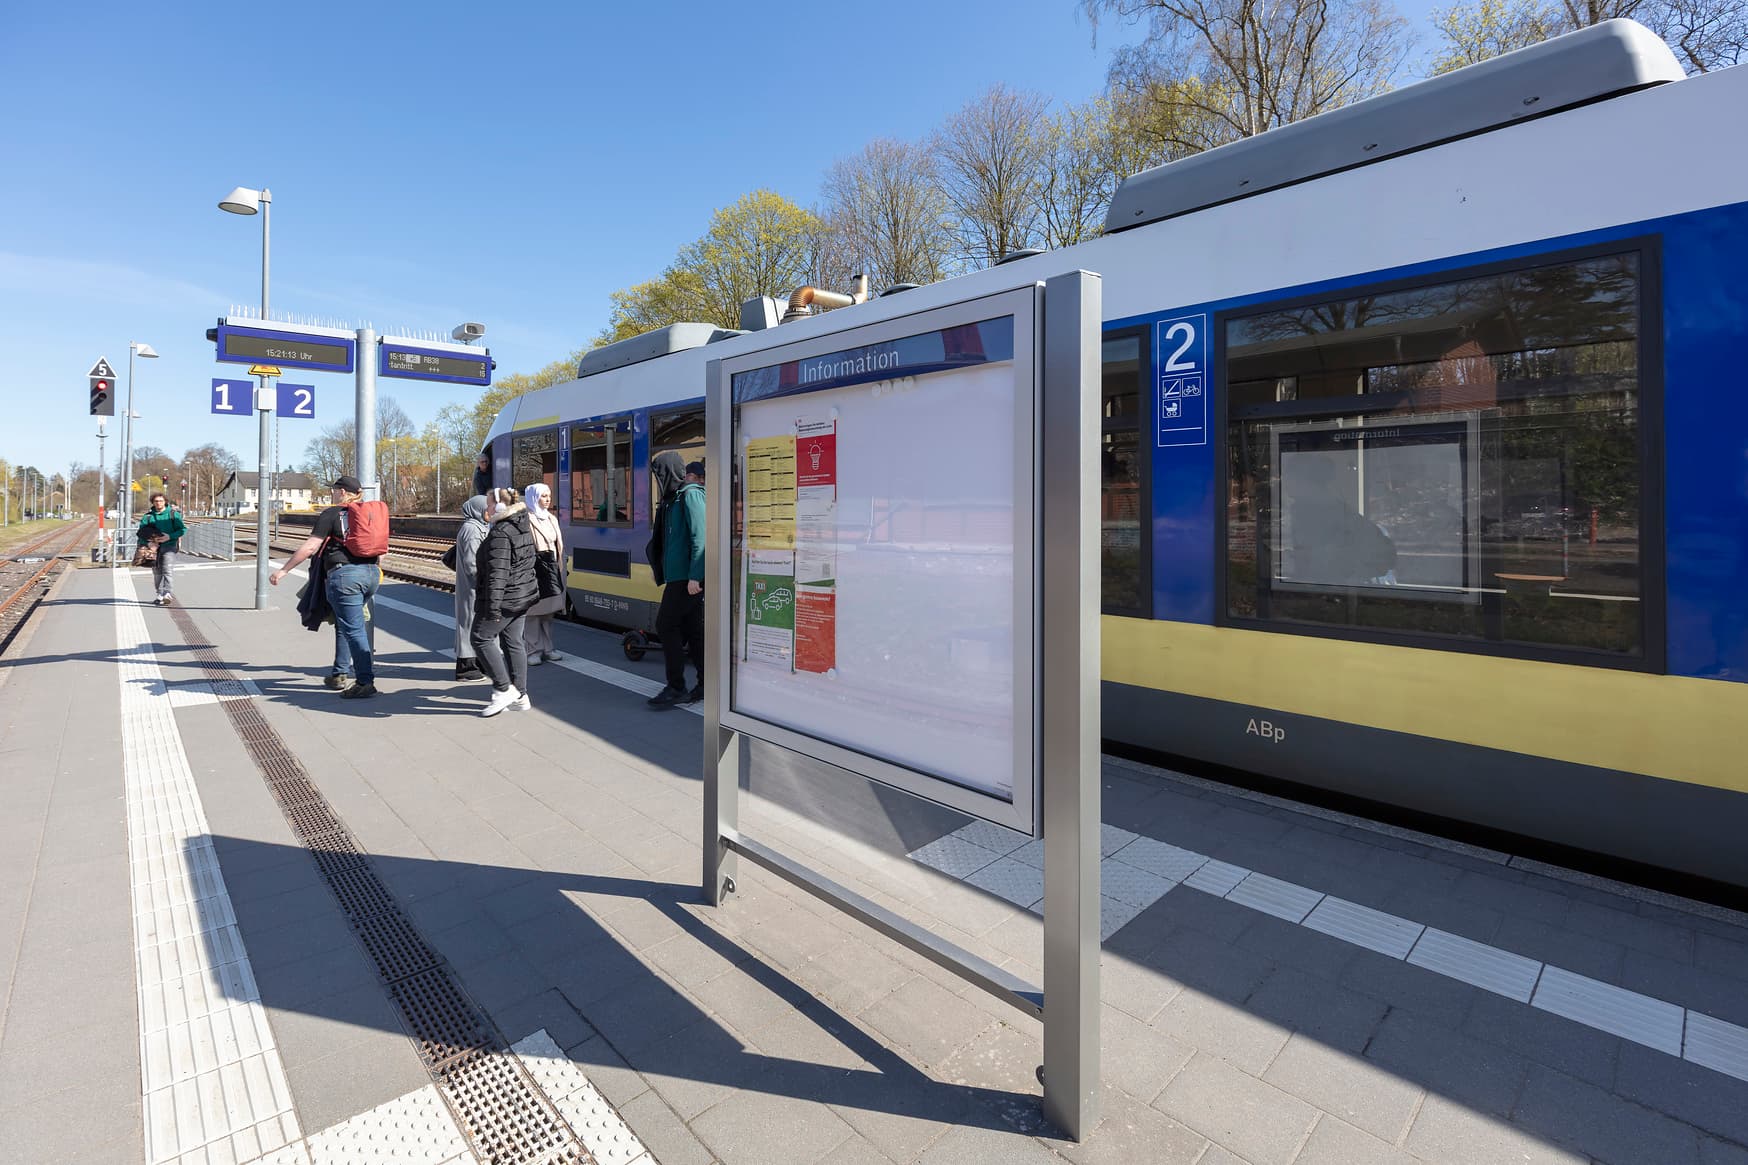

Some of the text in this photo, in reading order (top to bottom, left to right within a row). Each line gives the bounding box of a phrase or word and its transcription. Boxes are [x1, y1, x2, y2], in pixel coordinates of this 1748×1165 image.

[266, 348, 313, 361] 15:21:13 Uhr
[1165, 322, 1195, 372] 2
[99, 364, 107, 376] 5
[803, 350, 899, 383] Information
[215, 383, 233, 411] 1
[294, 389, 312, 415] 2
[1246, 718, 1286, 744] ABp
